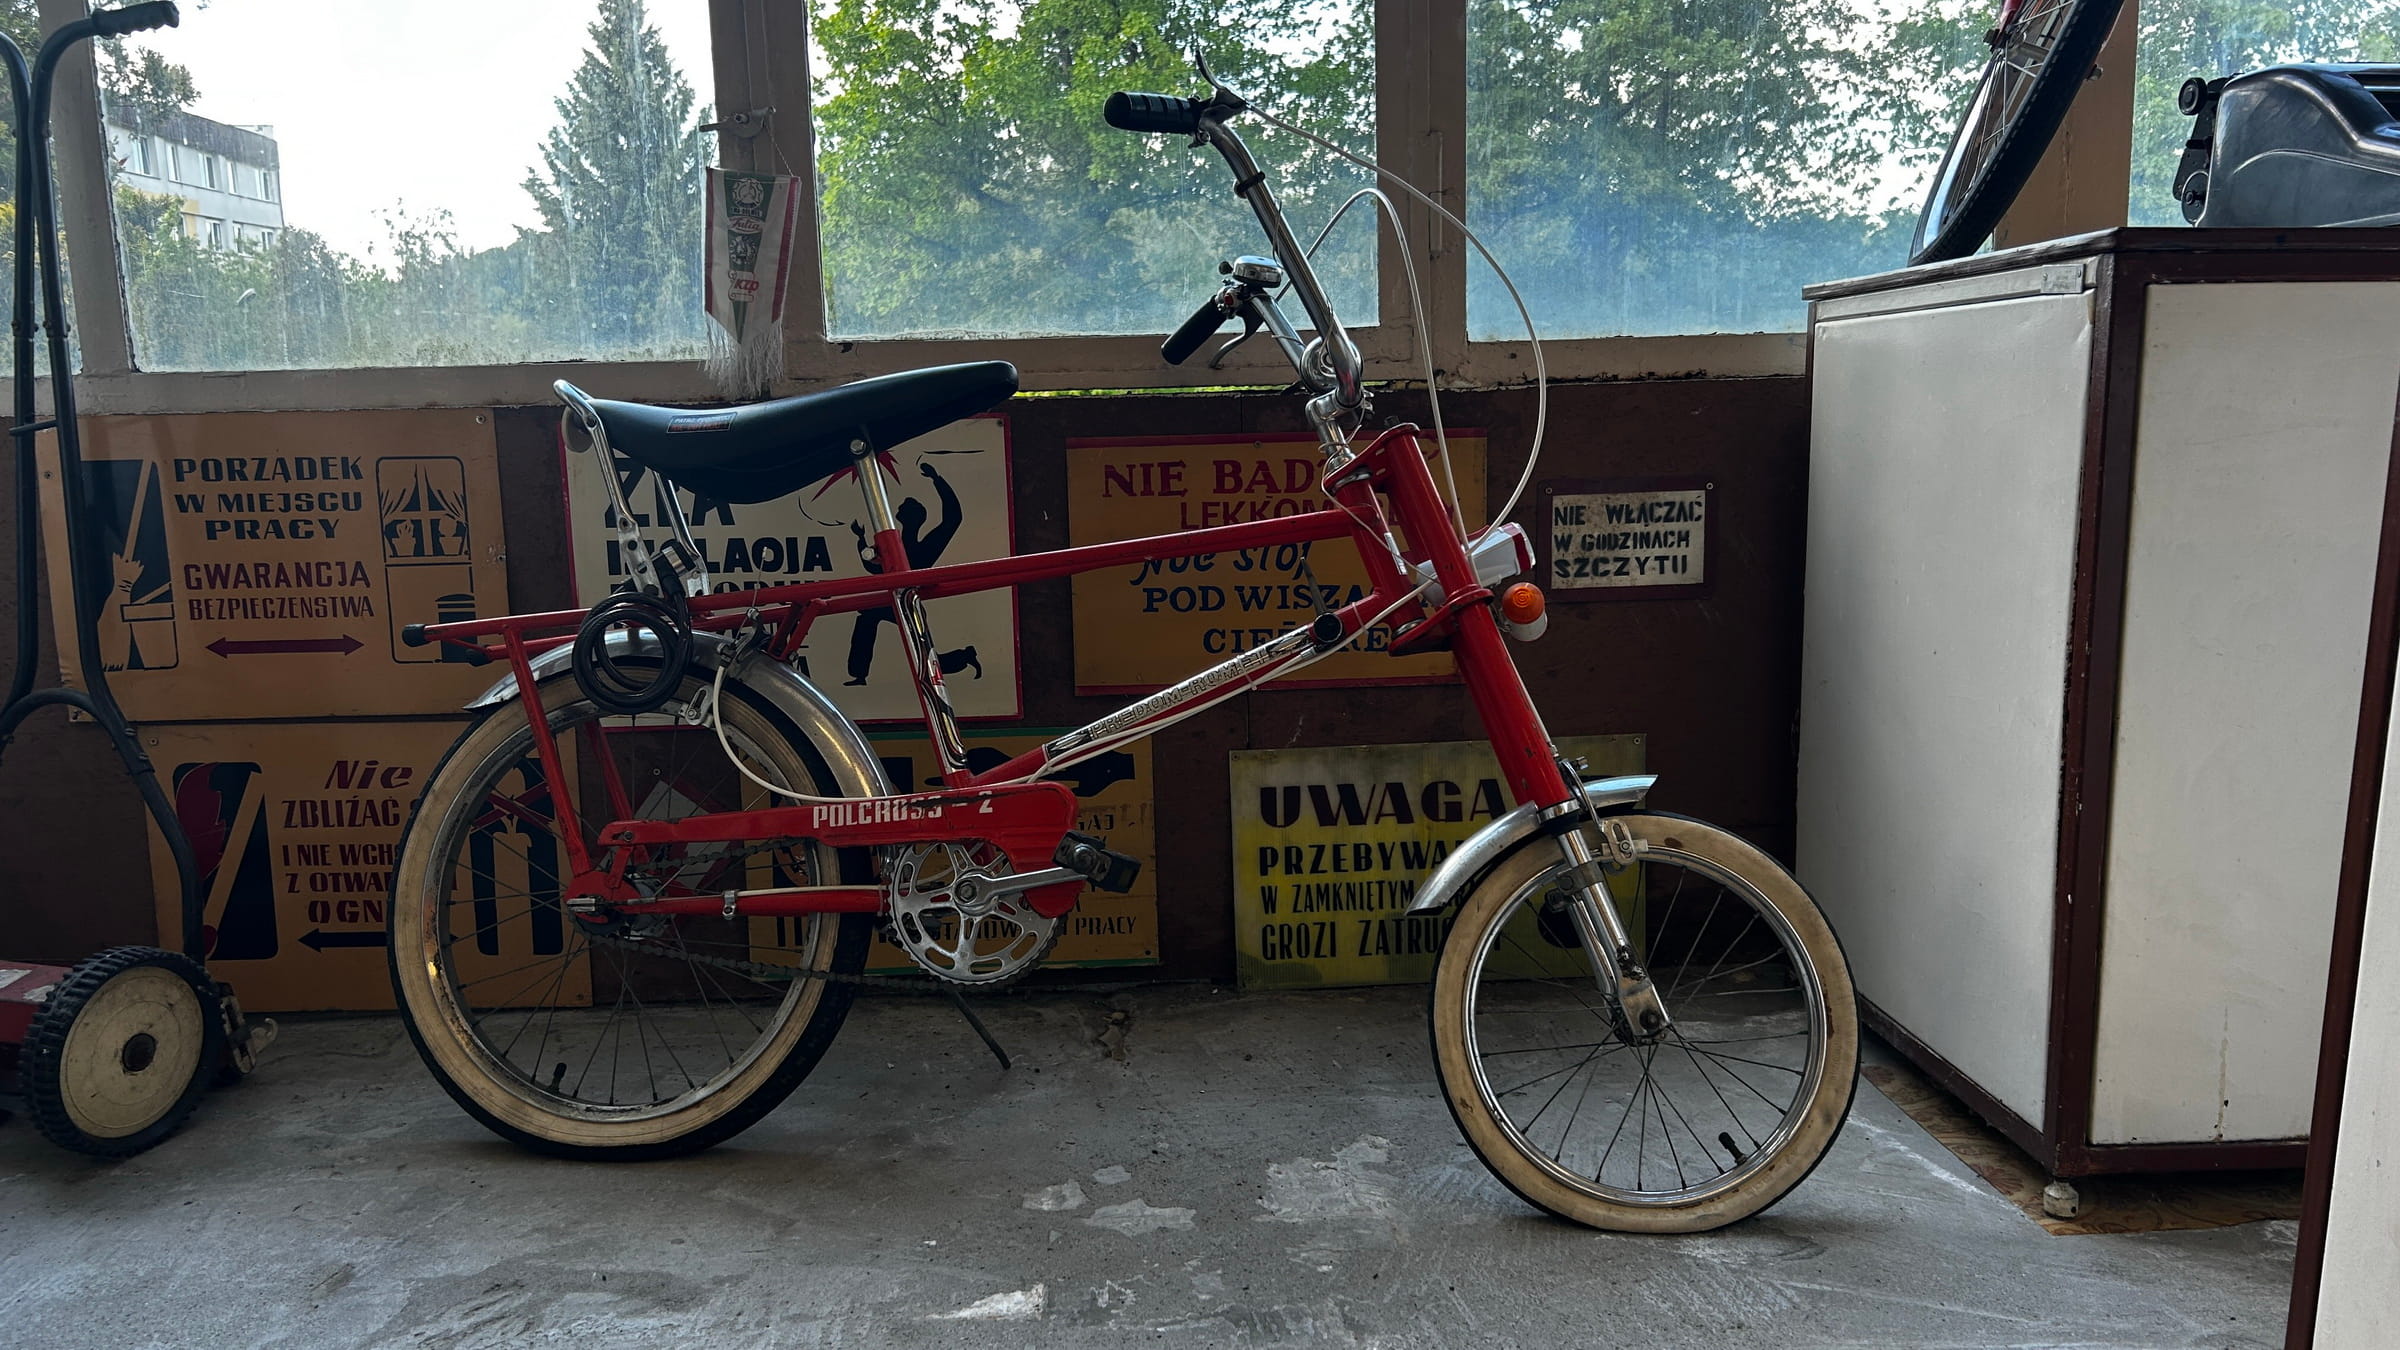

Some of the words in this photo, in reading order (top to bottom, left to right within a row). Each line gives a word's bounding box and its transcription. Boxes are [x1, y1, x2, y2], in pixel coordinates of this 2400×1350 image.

[174, 456, 363, 482] PORZĄDEK
[1102, 460, 1188, 497] NIE
[174, 494, 205, 513] W
[217, 492, 362, 512] MIEJSCU
[1554, 505, 1586, 526] NIE
[1605, 496, 1701, 527] WŁĄCZAĆ
[205, 519, 339, 540] PRACY
[1554, 535, 1572, 552] W
[1581, 530, 1690, 551] GODZINACH
[184, 561, 370, 590] GWARANCJA
[1554, 555, 1688, 578] SZCZYTU
[1143, 586, 1225, 613] POD
[324, 760, 413, 789] Nie
[812, 796, 943, 829] POLCROSS
[978, 791, 993, 814] 2
[1259, 779, 1506, 828] UWAGA
[282, 844, 291, 866] I
[297, 844, 331, 866] NIE
[1259, 839, 1463, 876] PRZEBYWA
[285, 873, 300, 893] Z
[1261, 885, 1277, 914] W
[1292, 880, 1415, 913] ZAMKNIĘTYM
[1075, 916, 1137, 935] PRACY
[1262, 922, 1336, 960] GROZI
